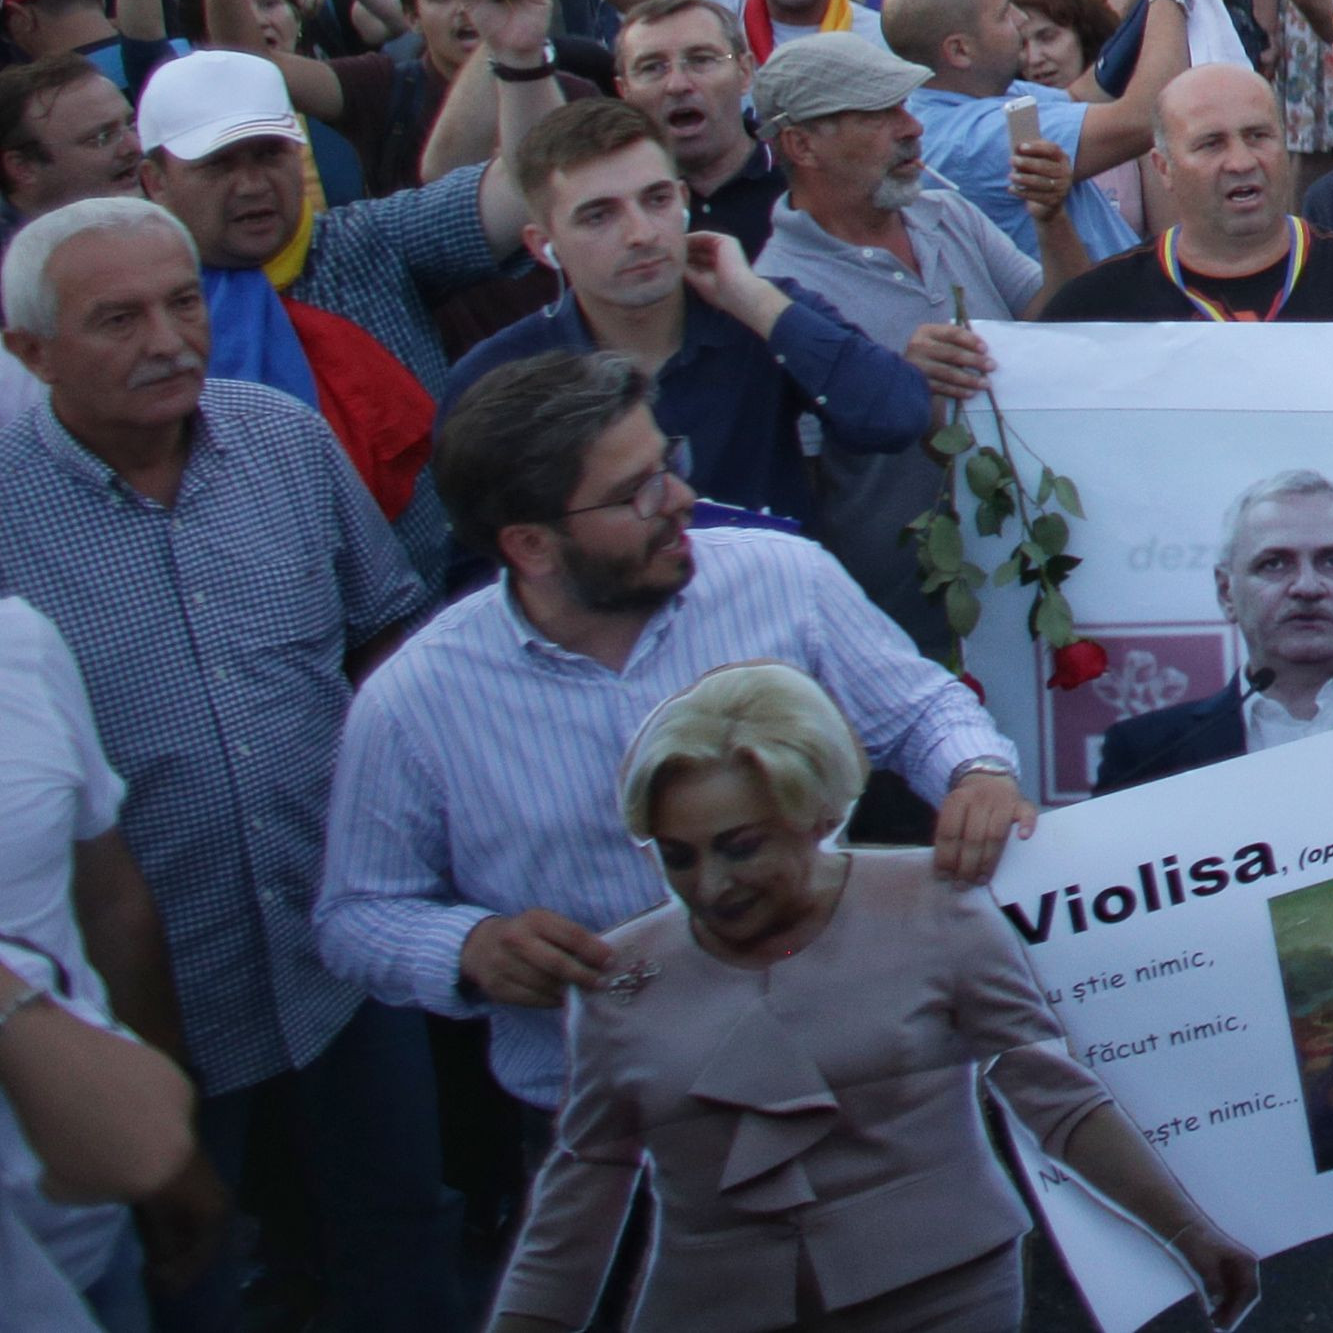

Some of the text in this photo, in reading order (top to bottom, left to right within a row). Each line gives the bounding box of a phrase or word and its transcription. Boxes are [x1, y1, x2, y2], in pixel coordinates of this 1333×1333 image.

[1047, 950, 1215, 1005] u știe nimic,
[1085, 1015, 1249, 1067] făcut nimic,
[1143, 1092, 1299, 1147] ește nimic...
